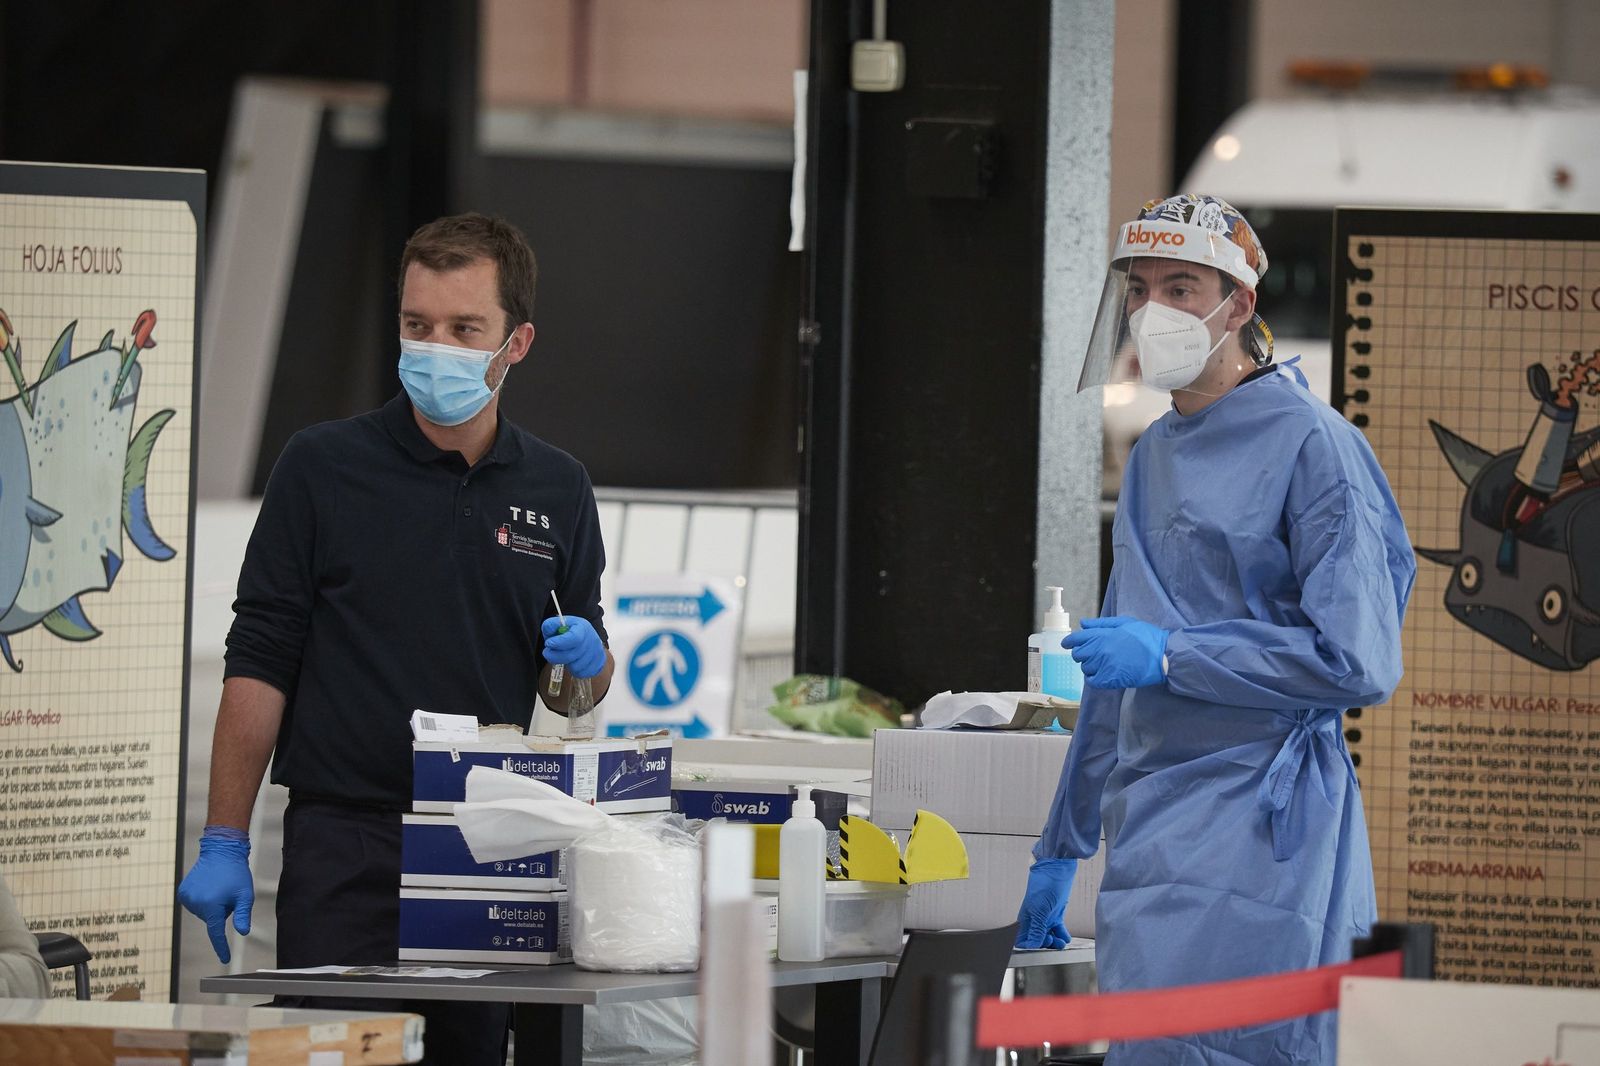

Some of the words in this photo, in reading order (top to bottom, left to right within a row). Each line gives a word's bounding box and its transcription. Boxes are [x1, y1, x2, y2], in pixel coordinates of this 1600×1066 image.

[1127, 223, 1185, 249] blayco
[23, 244, 66, 272] HOJA
[72, 246, 122, 274] FOLIUS
[1489, 284, 1579, 311] PISCIS
[509, 506, 550, 529] TES
[1412, 692, 1484, 709] NOMBRE
[26, 708, 61, 727] Papelico
[1457, 722, 1495, 736] forma
[1500, 725, 1515, 737] de
[1577, 731, 1583, 743] y
[25, 747, 48, 758] cauces
[88, 745, 100, 756] que
[1493, 743, 1578, 756] componentes
[22, 765, 42, 774] menor
[514, 760, 560, 773] deltalab
[1409, 768, 1474, 782] altamente
[1479, 773, 1573, 788] contaminantes
[21, 782, 40, 794] peces
[1409, 785, 1424, 796] de
[1444, 818, 1490, 831] acabar
[1494, 821, 1518, 832] con
[15, 832, 56, 847] descompone
[1420, 834, 1449, 846] pero
[1480, 836, 1524, 849] mucho
[1407, 860, 1544, 881] KREMA-ARRAINA
[501, 908, 545, 920] deltalab
